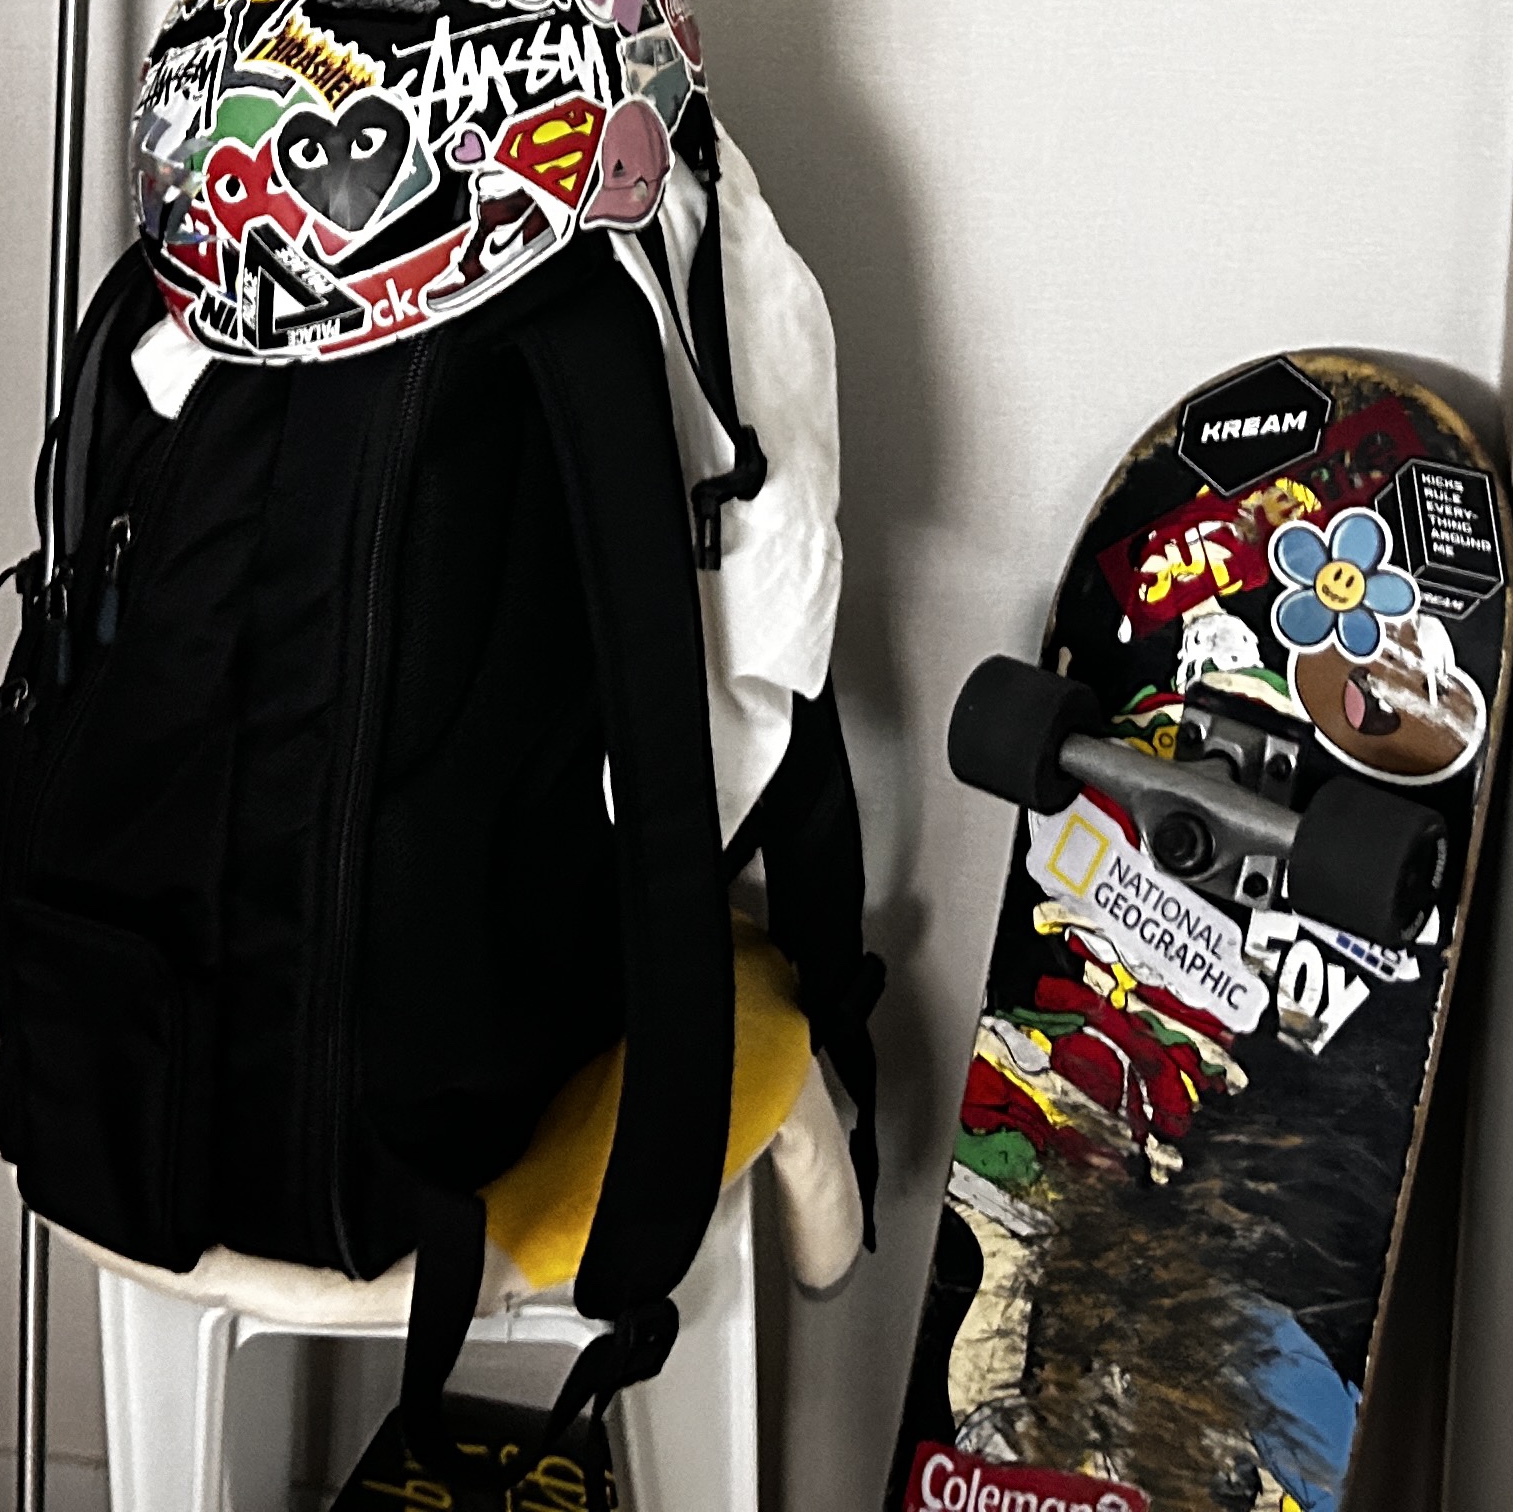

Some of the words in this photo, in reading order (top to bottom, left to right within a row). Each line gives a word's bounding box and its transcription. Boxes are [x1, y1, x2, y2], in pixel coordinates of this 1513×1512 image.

[1201, 410, 1308, 444] KREAM
[1421, 472, 1465, 493] KICKS
[1423, 487, 1462, 505] RULE
[1428, 514, 1473, 535] THING
[1431, 527, 1492, 553] AROUND
[1433, 541, 1455, 558] ME
[1109, 856, 1223, 961] NATIONAL
[1094, 881, 1248, 1010] GEOGRAPHIC
